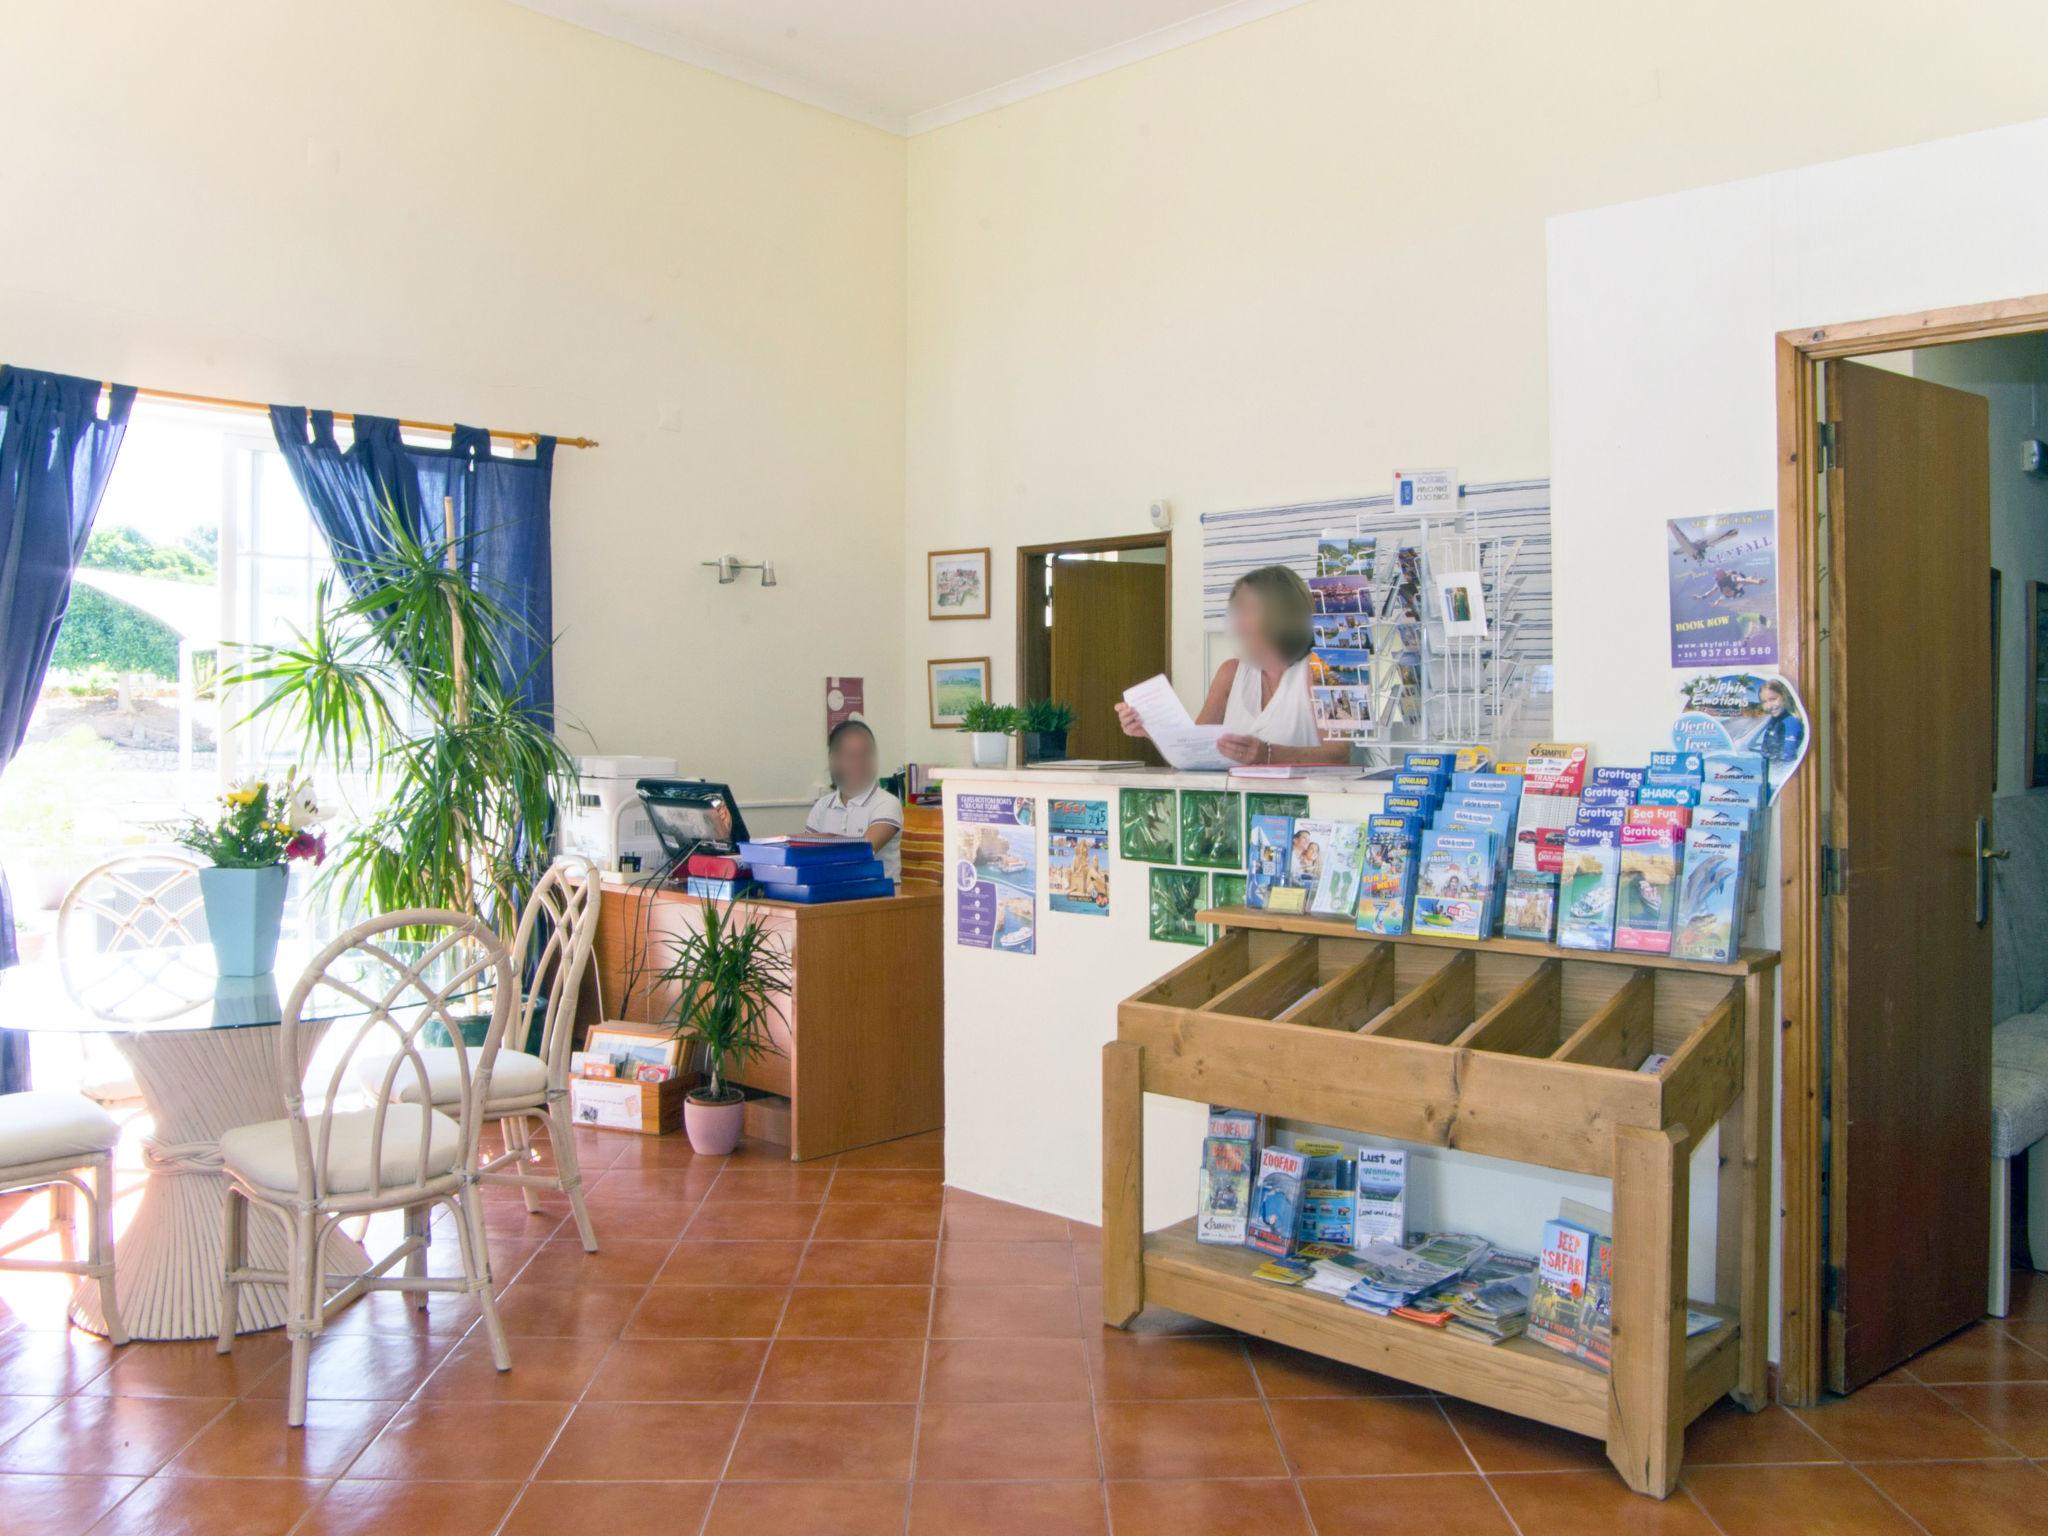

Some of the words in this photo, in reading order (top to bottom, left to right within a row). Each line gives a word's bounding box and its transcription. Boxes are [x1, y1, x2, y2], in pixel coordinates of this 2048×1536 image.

[1707, 537, 1772, 564] SKYFALL
[1675, 618, 1705, 632] BOOK
[1707, 616, 1730, 626] NOW
[1701, 649, 1721, 657] 937
[1725, 648, 1746, 656] 055
[1694, 680, 1747, 694] Dolphin
[1692, 693, 1749, 707] Emotions
[1541, 749, 1567, 757] SIMPLY
[1652, 755, 1677, 765] REEF
[1534, 774, 1574, 783] TRANSFERS
[1598, 769, 1643, 780] Grottoes
[1584, 788, 1629, 798] Grottoes
[1641, 788, 1675, 798] SHARK
[1579, 808, 1623, 818] Grottoes
[1633, 809, 1654, 818] Sea
[1657, 809, 1676, 818] Fun
[1568, 827, 1614, 839] Grottoes
[1623, 826, 1671, 836] Grottoes
[1263, 1152, 1297, 1173] ZOOFARI
[1360, 1151, 1385, 1163] Lust
[1558, 1231, 1580, 1253] JEEP
[1548, 1250, 1584, 1276] SAFARI
